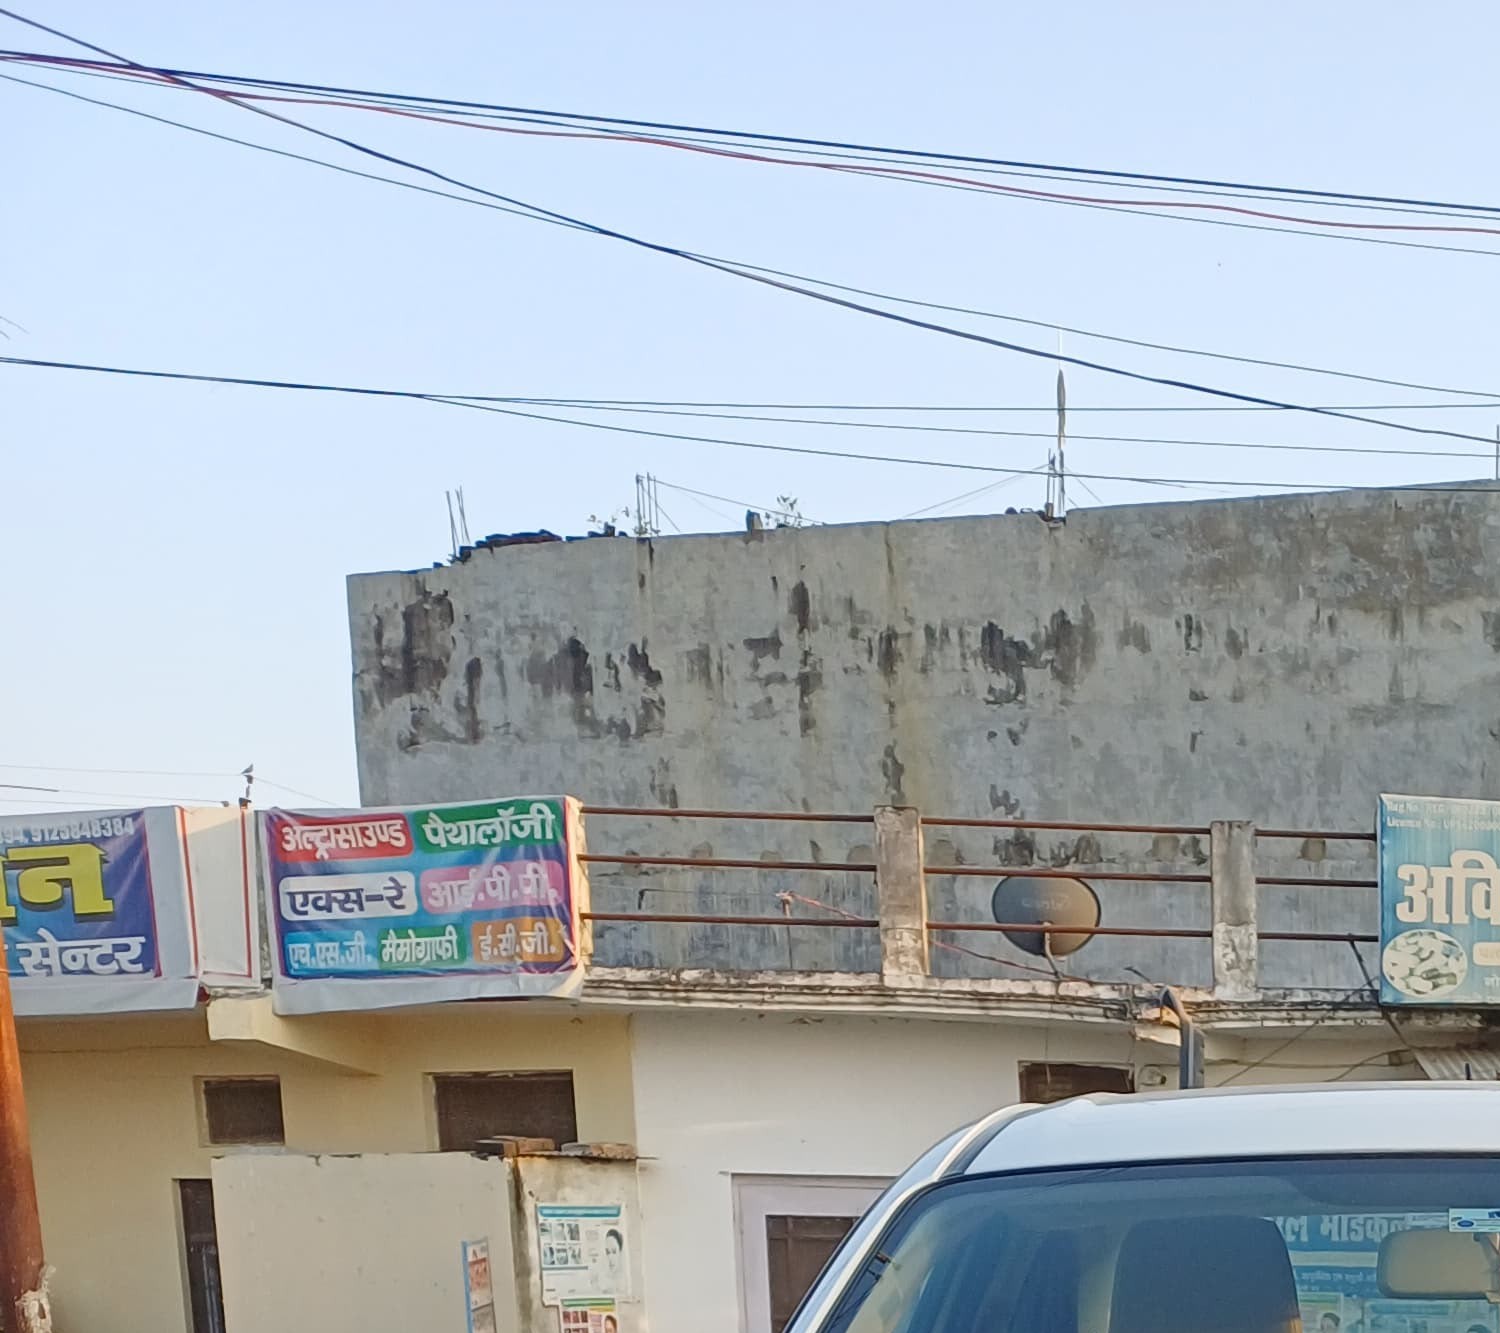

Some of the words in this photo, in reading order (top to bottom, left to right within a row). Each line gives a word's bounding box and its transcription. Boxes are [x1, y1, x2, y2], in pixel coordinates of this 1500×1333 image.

[281, 819, 406, 860] अल्ट्रासाउण्ड
[421, 802, 556, 847] पैथालॉजी
[285, 875, 407, 915] एक्स-रे
[16, 927, 146, 977] सेन्टर
